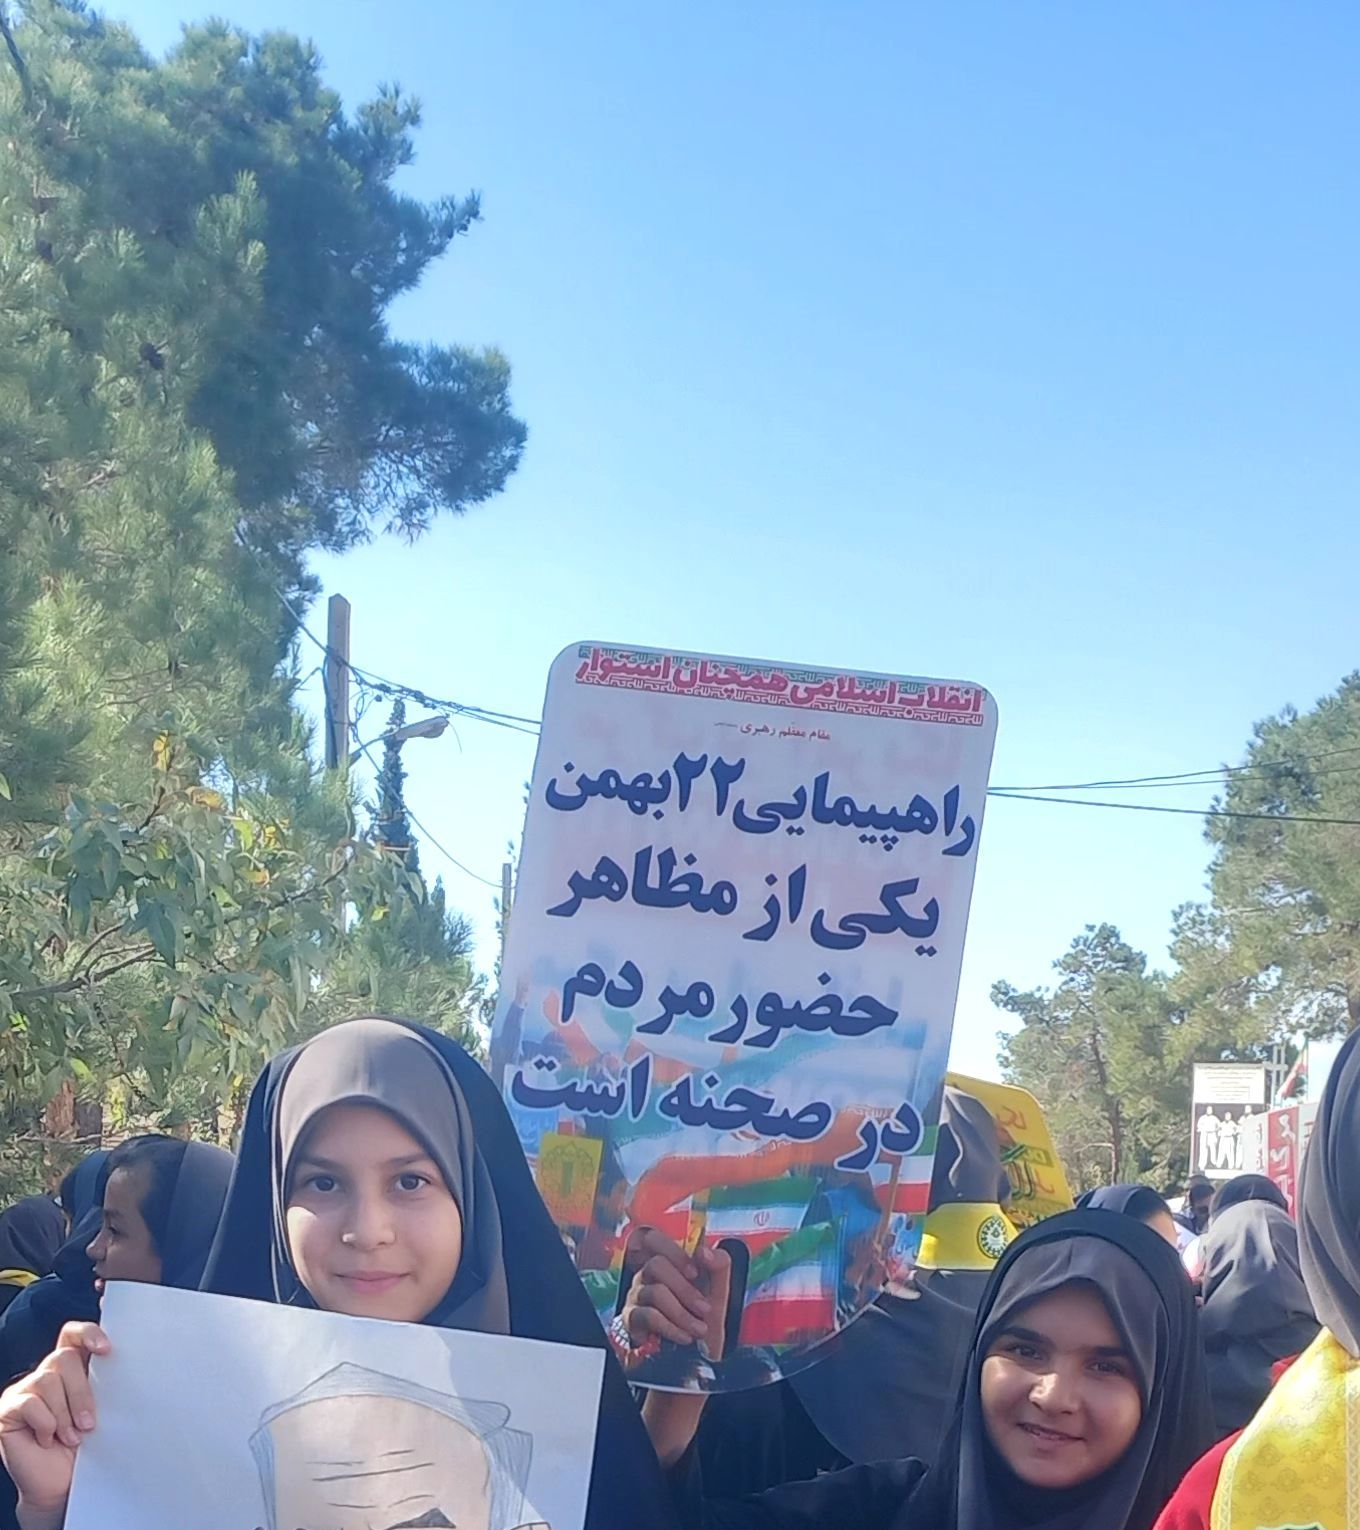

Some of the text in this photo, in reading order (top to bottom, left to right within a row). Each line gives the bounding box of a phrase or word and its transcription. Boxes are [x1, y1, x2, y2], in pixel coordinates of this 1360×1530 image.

[575, 647, 983, 718] انقلاب اسلامی همچنان استوار
[739, 721, 777, 738] رهبری
[544, 758, 672, 820] بهمن
[547, 846, 940, 957] یکی از مظاهر
[561, 959, 899, 1049] حضور مردم
[510, 1056, 923, 1170] در صحنه است
